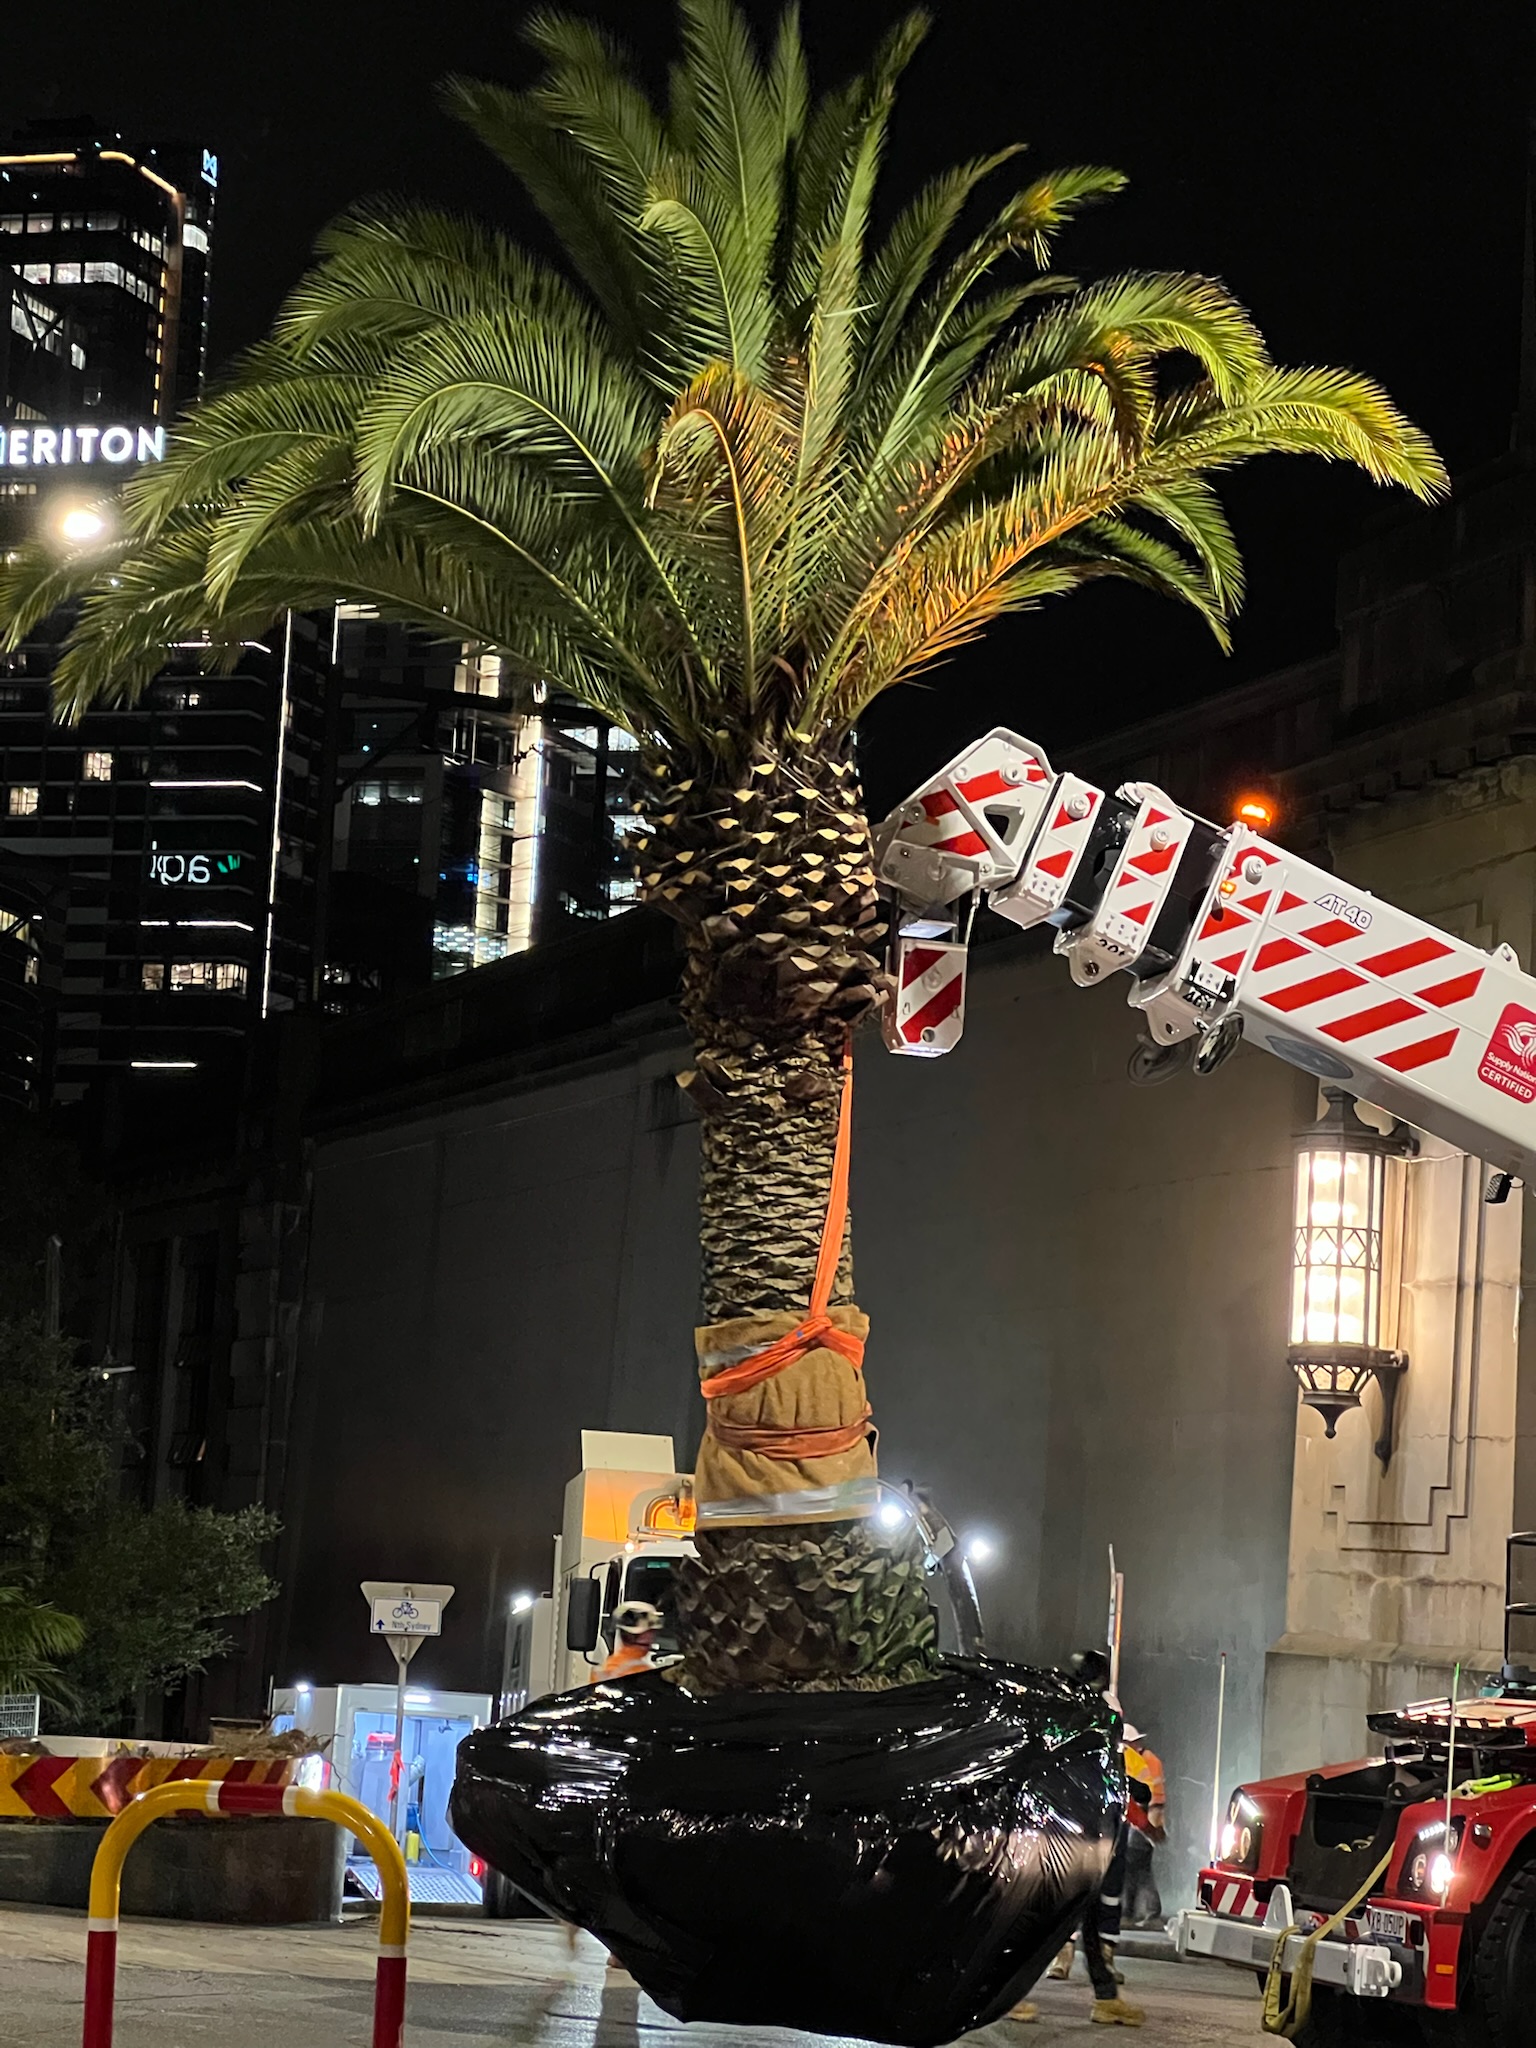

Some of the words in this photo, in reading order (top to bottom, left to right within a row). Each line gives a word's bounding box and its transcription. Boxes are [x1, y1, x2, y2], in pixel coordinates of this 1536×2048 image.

[1487, 1051, 1513, 1073] Supply
[1481, 1066, 1533, 1099] CERTIFIED
[407, 1621, 432, 1631] Sydney
